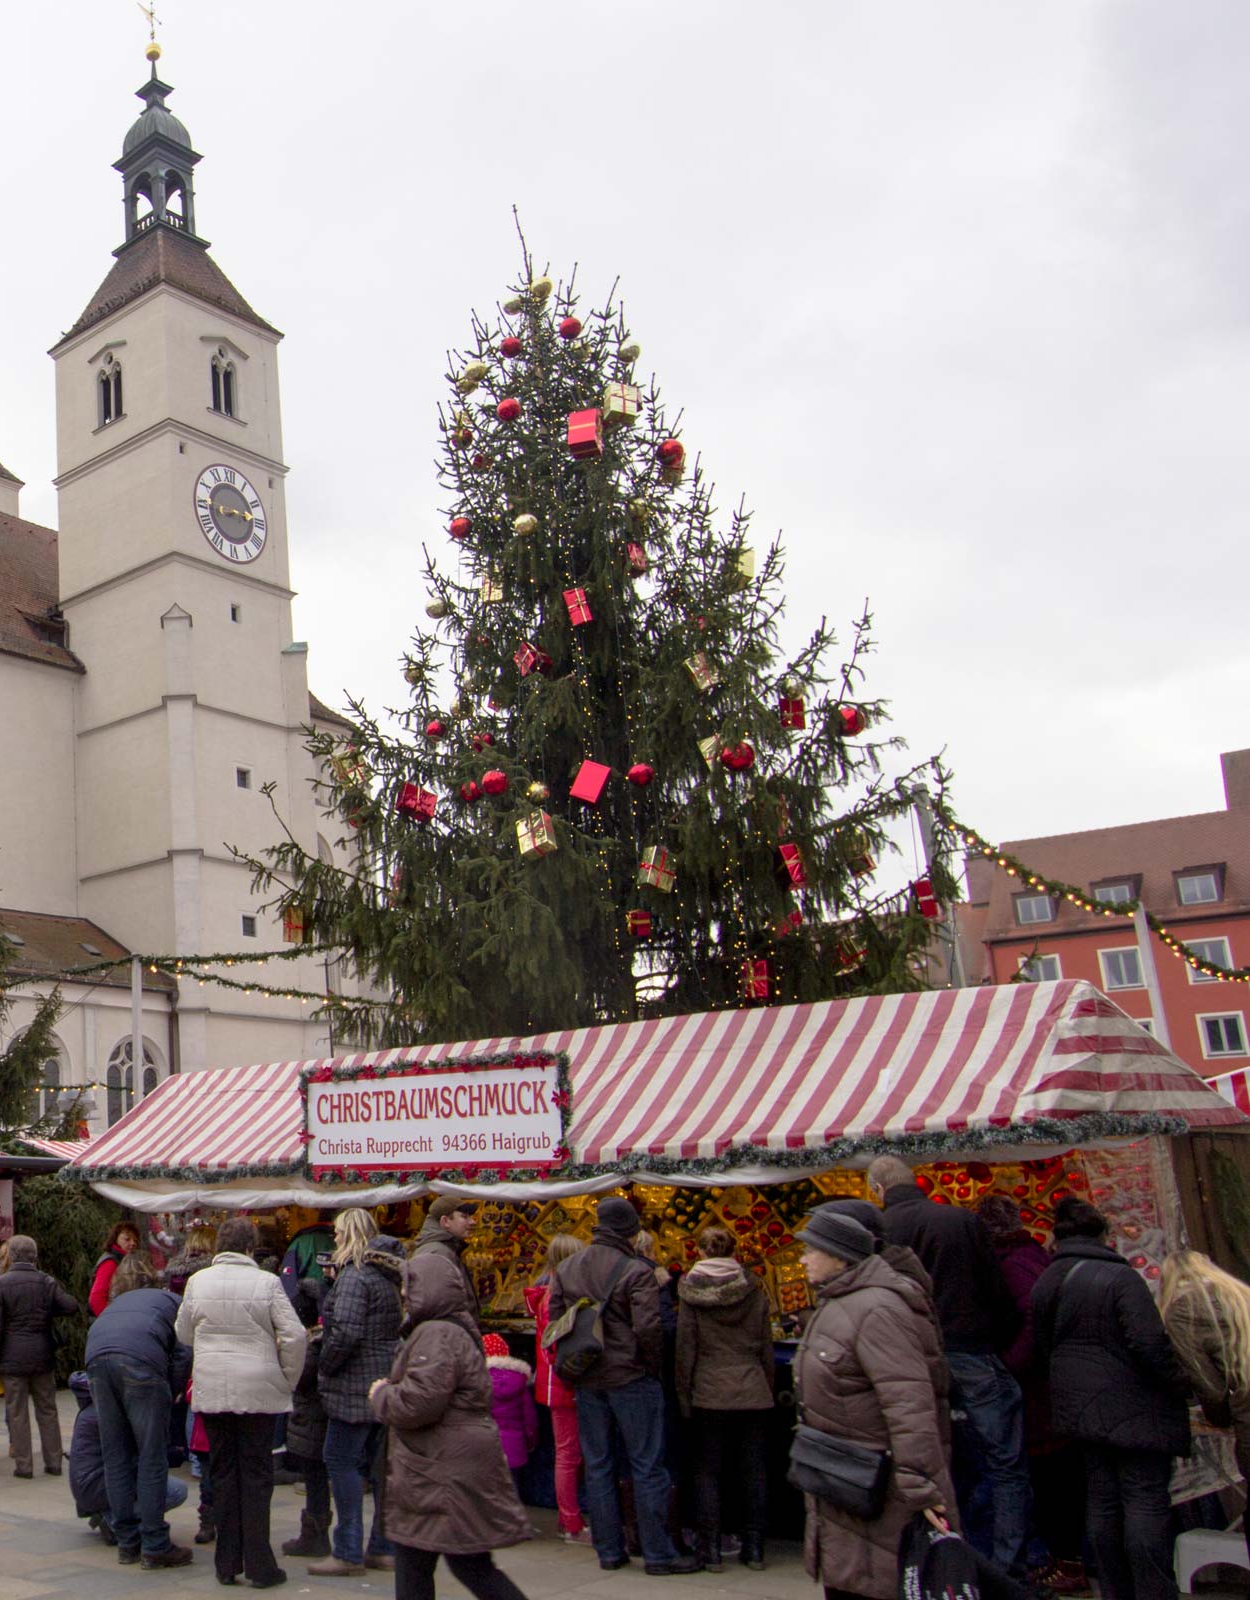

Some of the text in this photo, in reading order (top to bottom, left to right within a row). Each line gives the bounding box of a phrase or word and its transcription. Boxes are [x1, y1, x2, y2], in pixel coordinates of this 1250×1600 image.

[209, 468, 222, 484] XI
[223, 468, 236, 485] XII
[199, 478, 211, 493] X
[240, 481, 247, 492] I
[249, 499, 260, 509] II
[200, 514, 215, 534] VIII
[254, 518, 265, 531] III
[211, 532, 224, 551] VII
[230, 543, 239, 559] VI
[244, 545, 252, 559] V
[316, 1080, 549, 1125] CHRISTBAUMSCHMUCK
[318, 1132, 551, 1158] Christa Rupprecht 94366 Haigrub
